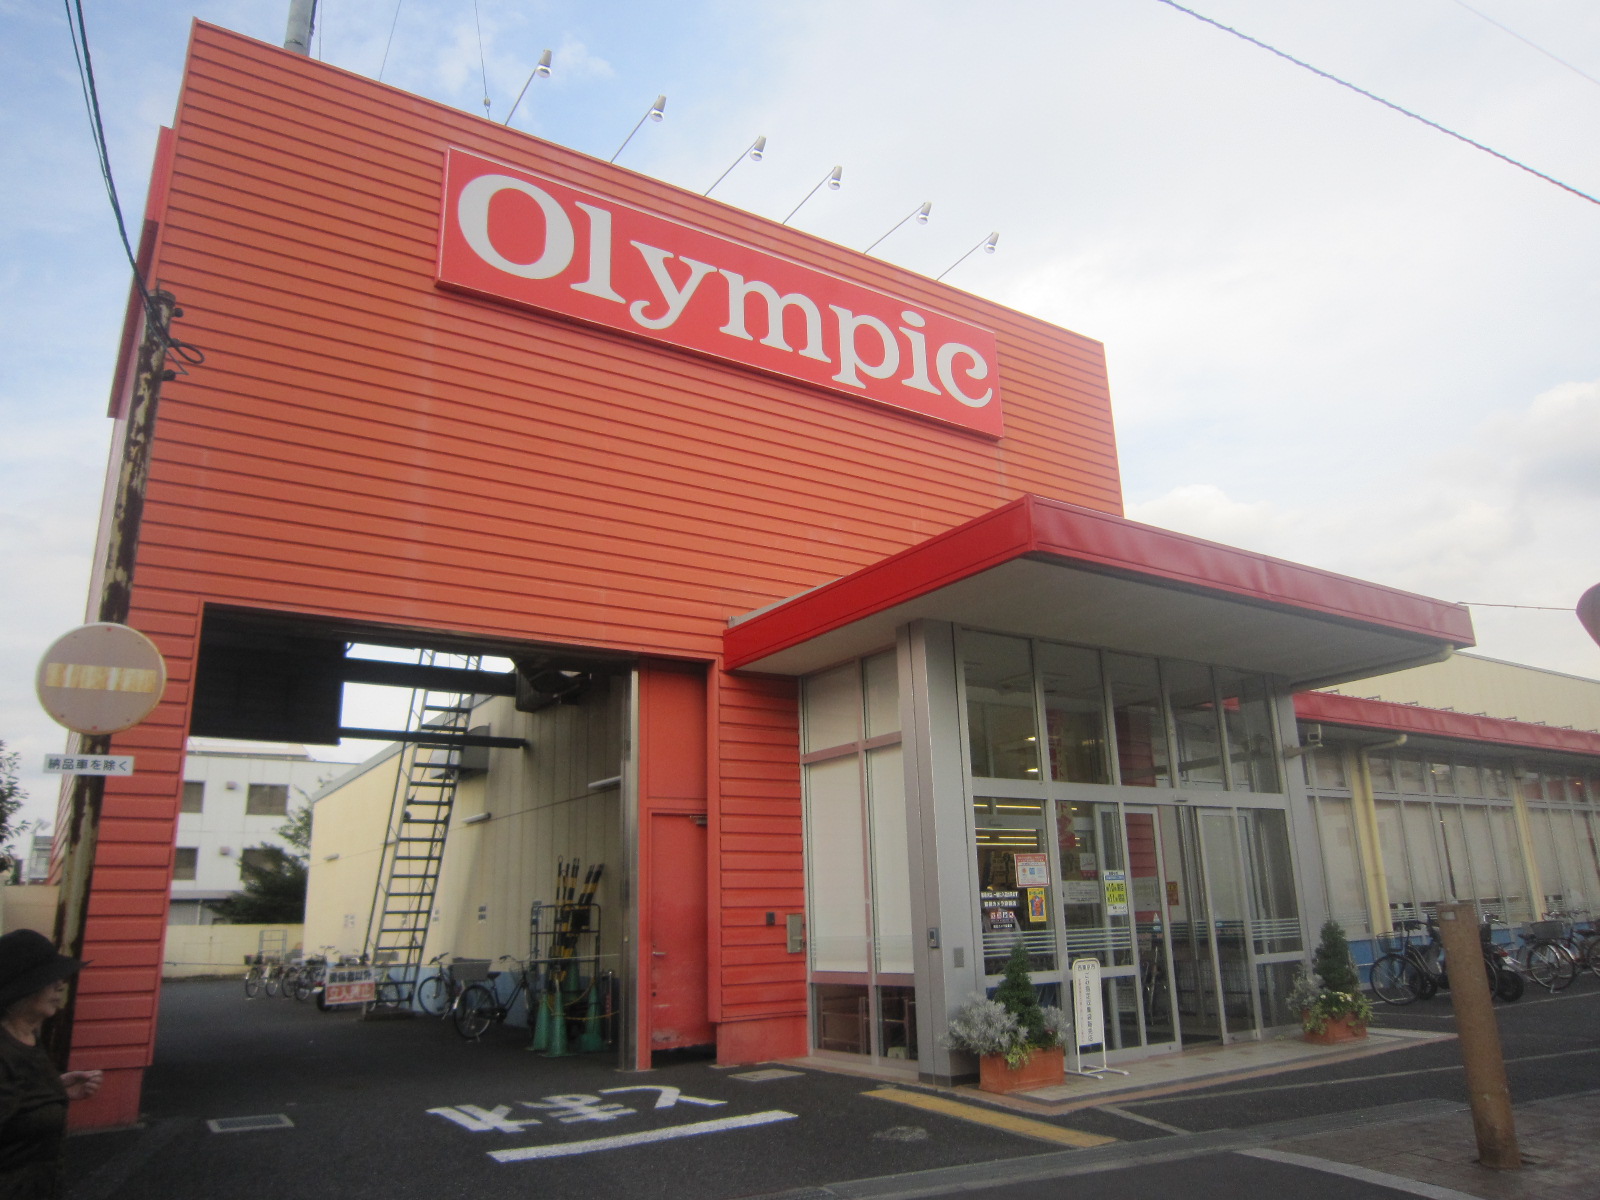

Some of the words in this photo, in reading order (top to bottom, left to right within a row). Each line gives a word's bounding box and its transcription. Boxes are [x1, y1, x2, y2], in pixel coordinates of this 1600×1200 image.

[458, 174, 992, 408] Olympic
[47, 757, 128, 772] 納品車を除く
